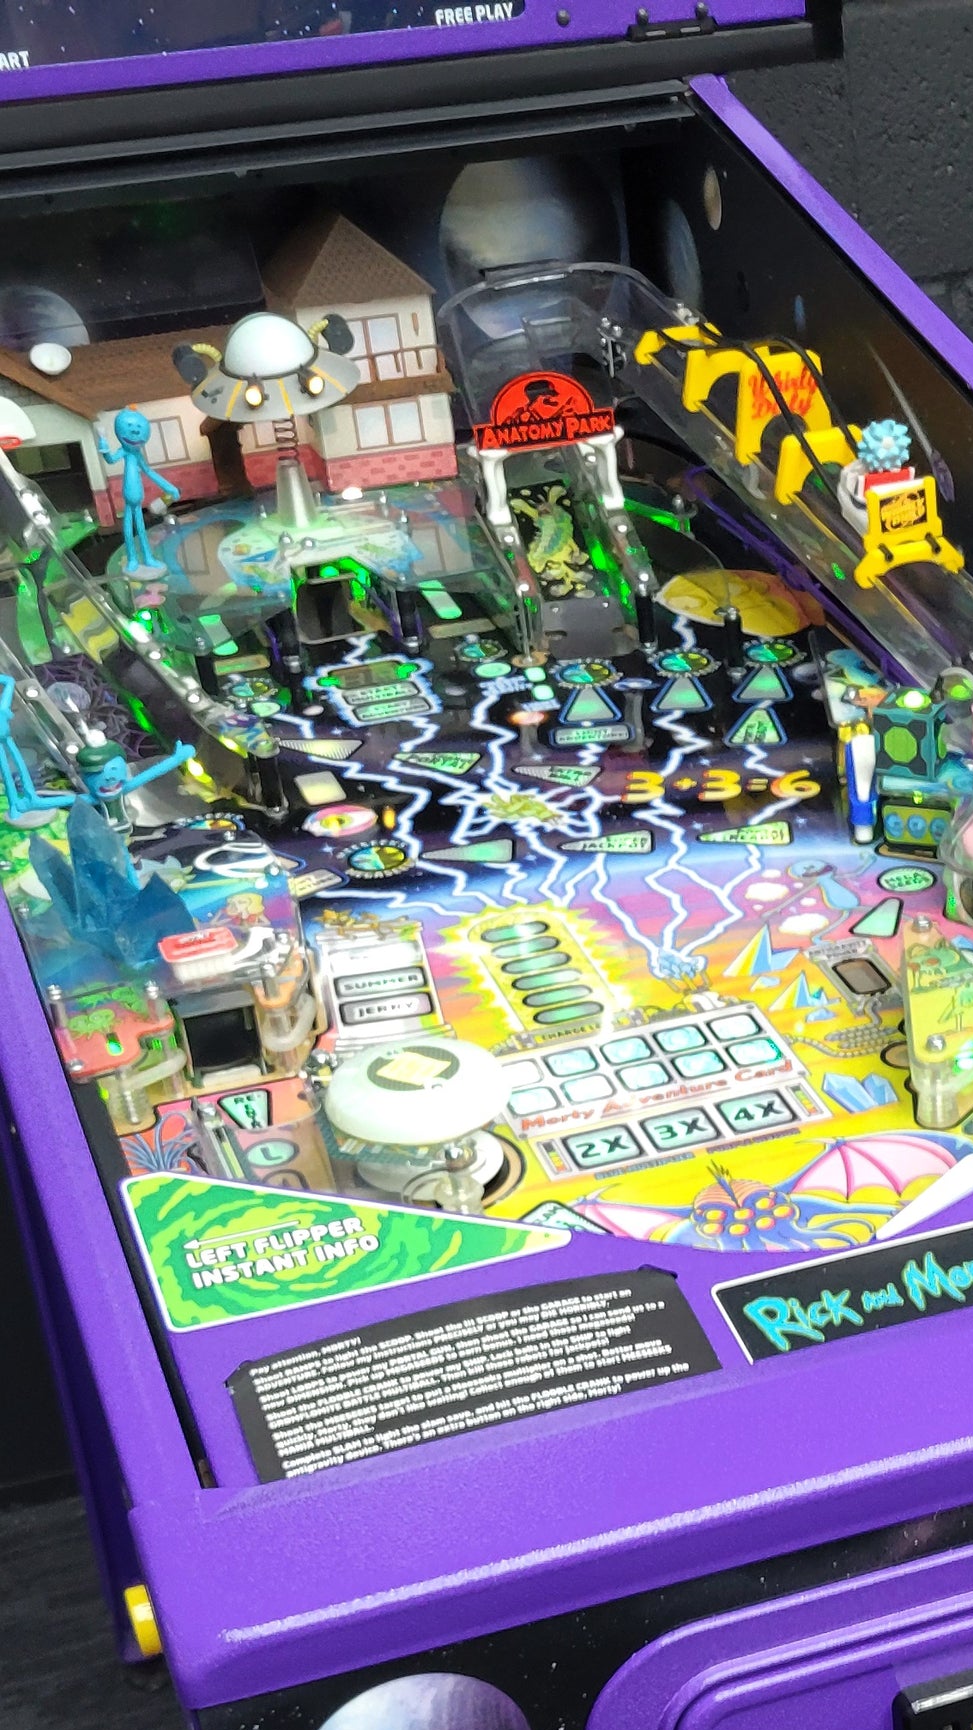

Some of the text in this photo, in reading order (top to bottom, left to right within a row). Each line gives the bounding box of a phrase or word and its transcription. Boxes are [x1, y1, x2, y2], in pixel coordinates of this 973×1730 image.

[435, 2, 514, 27] FREE PLAY
[482, 414, 611, 449] ANATOMY PARK
[521, 1060, 793, 1131] Morty Aventure Card
[575, 1134, 630, 1160] 2X
[654, 1117, 706, 1141] 3X
[733, 1100, 783, 1123] 4X
[186, 1217, 365, 1269] LEFT FLIPPER
[192, 1235, 380, 1289] INSTANT INFO
[743, 1288, 864, 1352] Rick
